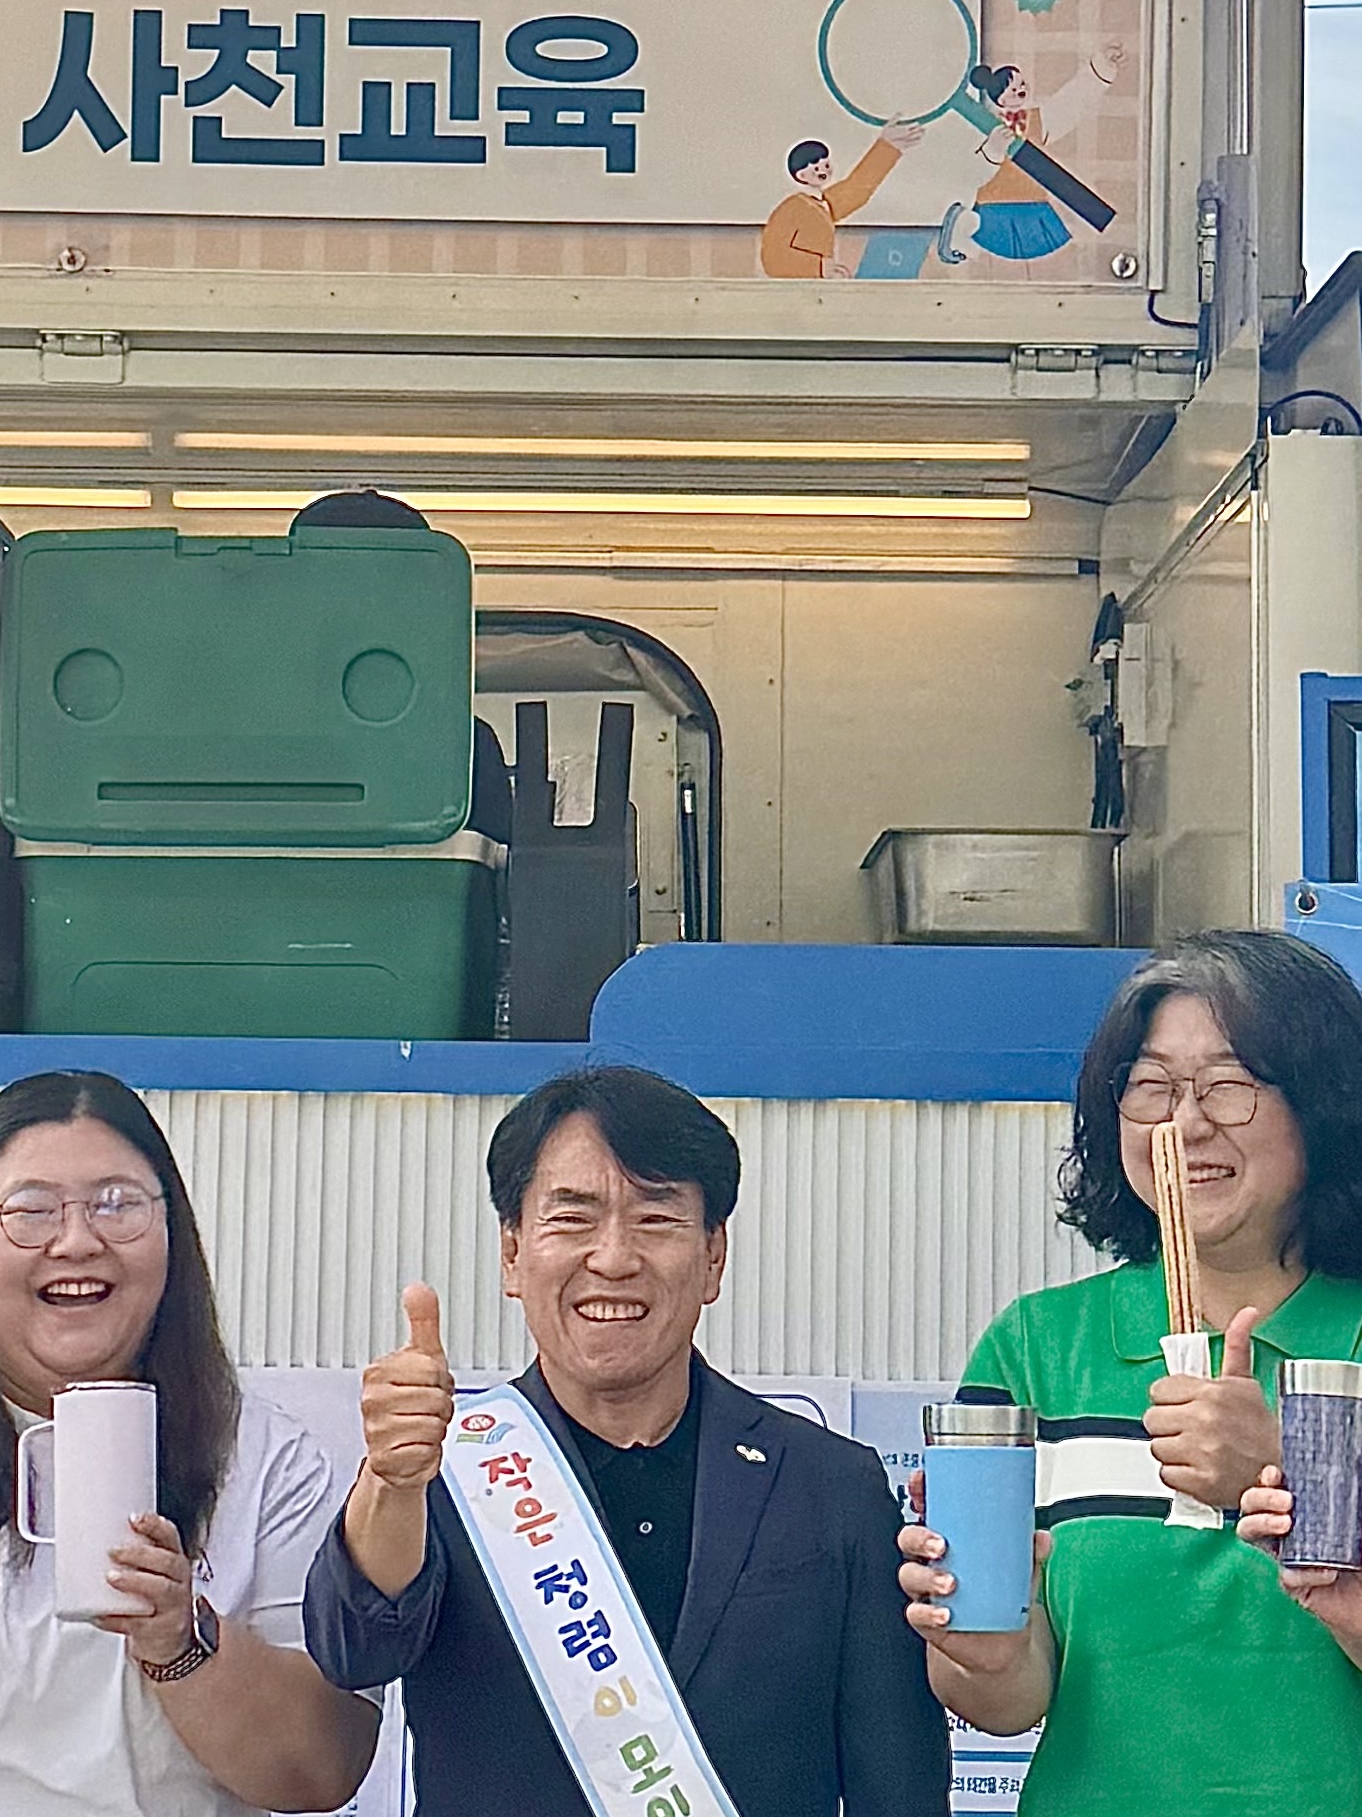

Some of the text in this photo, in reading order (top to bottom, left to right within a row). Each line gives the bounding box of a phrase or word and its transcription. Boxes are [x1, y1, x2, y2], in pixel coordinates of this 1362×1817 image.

[23, 9, 645, 173] 사천교육
[477, 1451, 558, 1548] 작은
[532, 1558, 638, 1718] 청렴이
